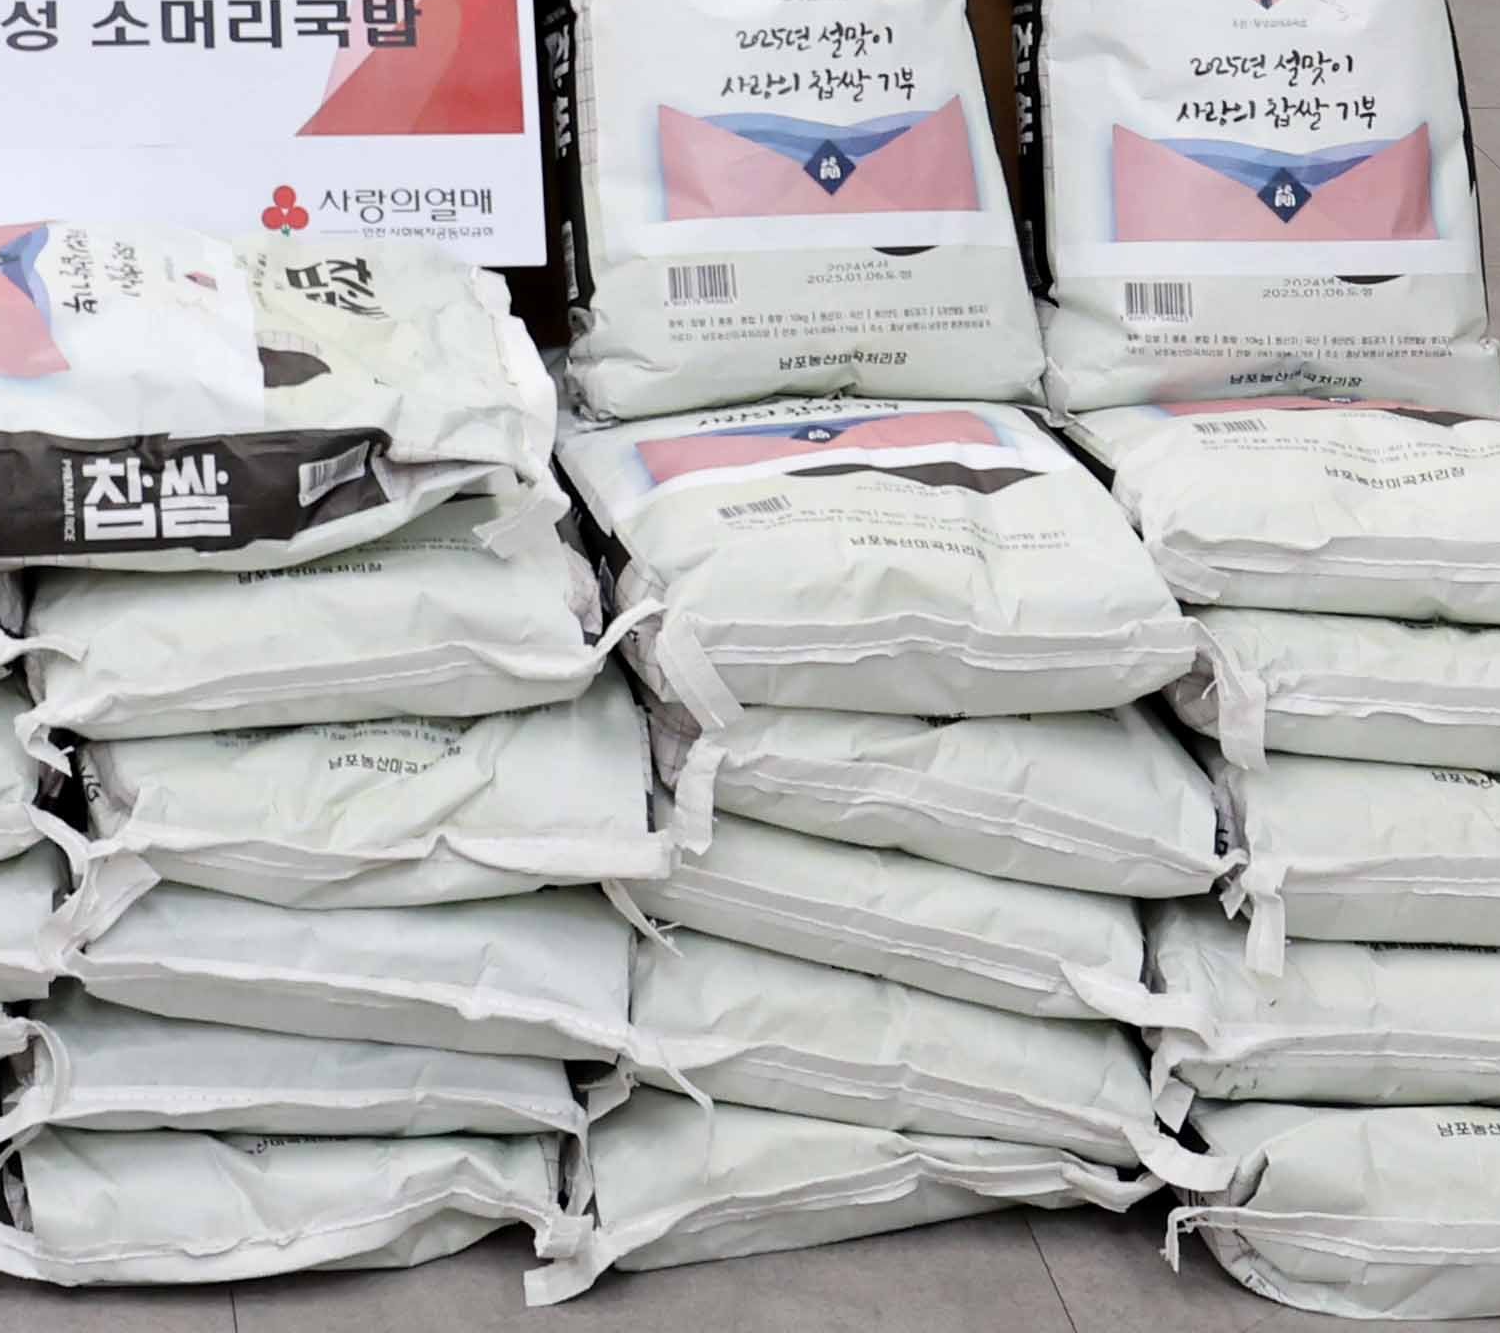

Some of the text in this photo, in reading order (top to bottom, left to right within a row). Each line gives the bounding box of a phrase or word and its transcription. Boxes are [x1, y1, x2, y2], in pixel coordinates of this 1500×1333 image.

[736, 20, 894, 58] 2025년 설맞이
[721, 66, 916, 102] 사랑의 찹쌀 기부
[1190, 50, 1353, 86] 2025년 설맞이
[1176, 95, 1378, 130] 사랑의 찹쌀 기부
[319, 187, 492, 224] 사랑의열매
[779, 349, 908, 371] 남포농산미곡처리장
[1323, 465, 1466, 490] 남포농산미곡처리장
[81, 453, 231, 541] 찹쌀
